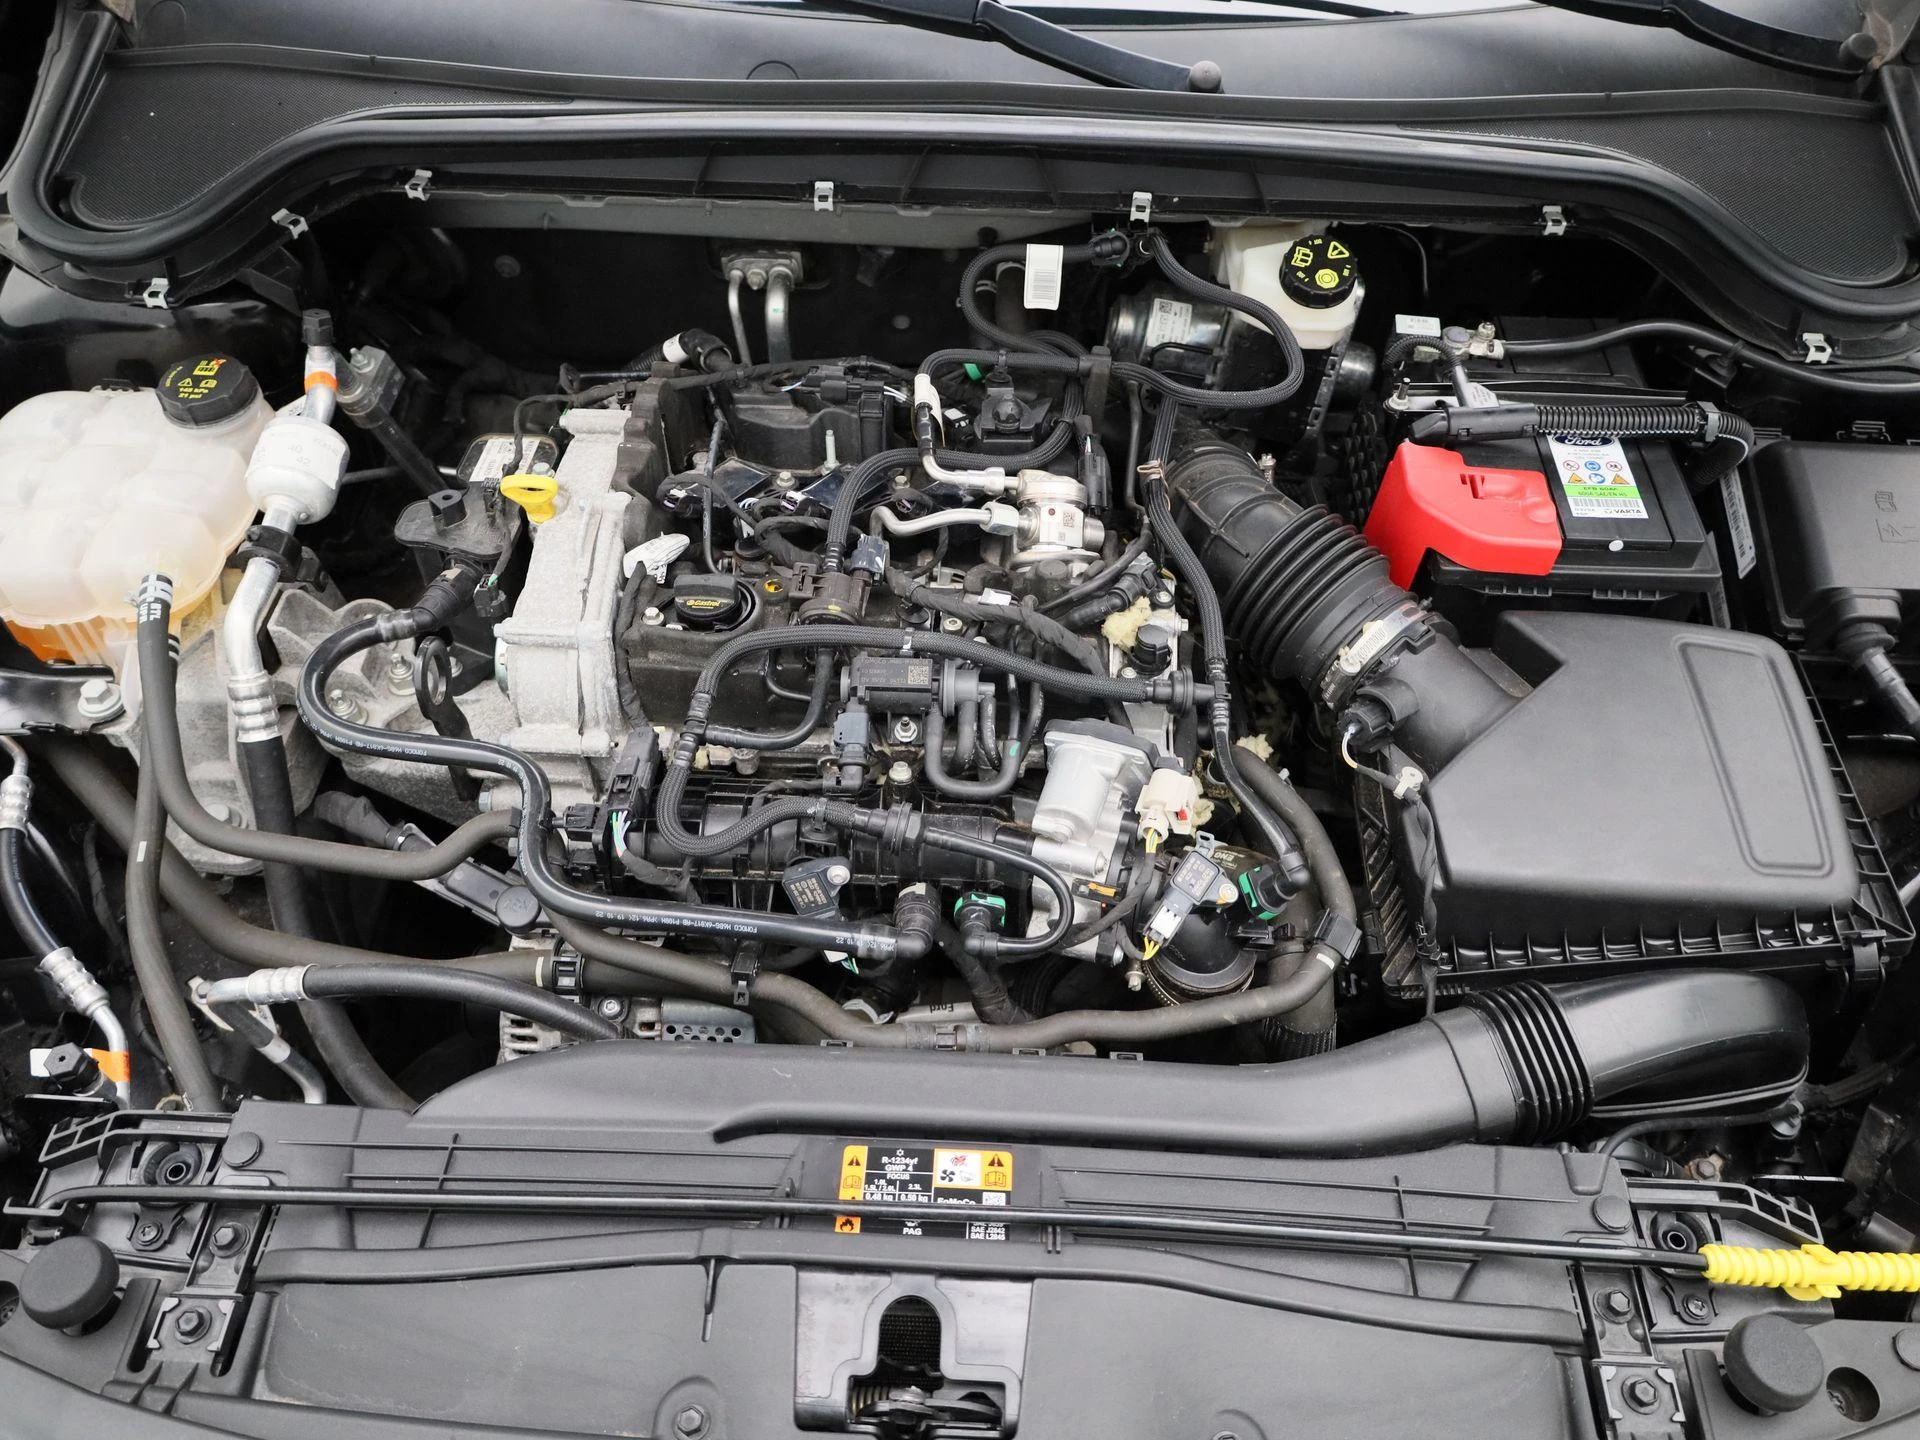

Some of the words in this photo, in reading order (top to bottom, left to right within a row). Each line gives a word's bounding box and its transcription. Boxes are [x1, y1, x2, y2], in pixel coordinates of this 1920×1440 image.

[881, 1156, 919, 1165] R-1234yf
[885, 1164, 907, 1172] GWP
[907, 1183, 923, 1191] 2.3L
[883, 1193, 894, 1202] kg
[917, 1194, 929, 1203] kg
[903, 1227, 922, 1236] PAG
[970, 1232, 986, 1240] SAE
